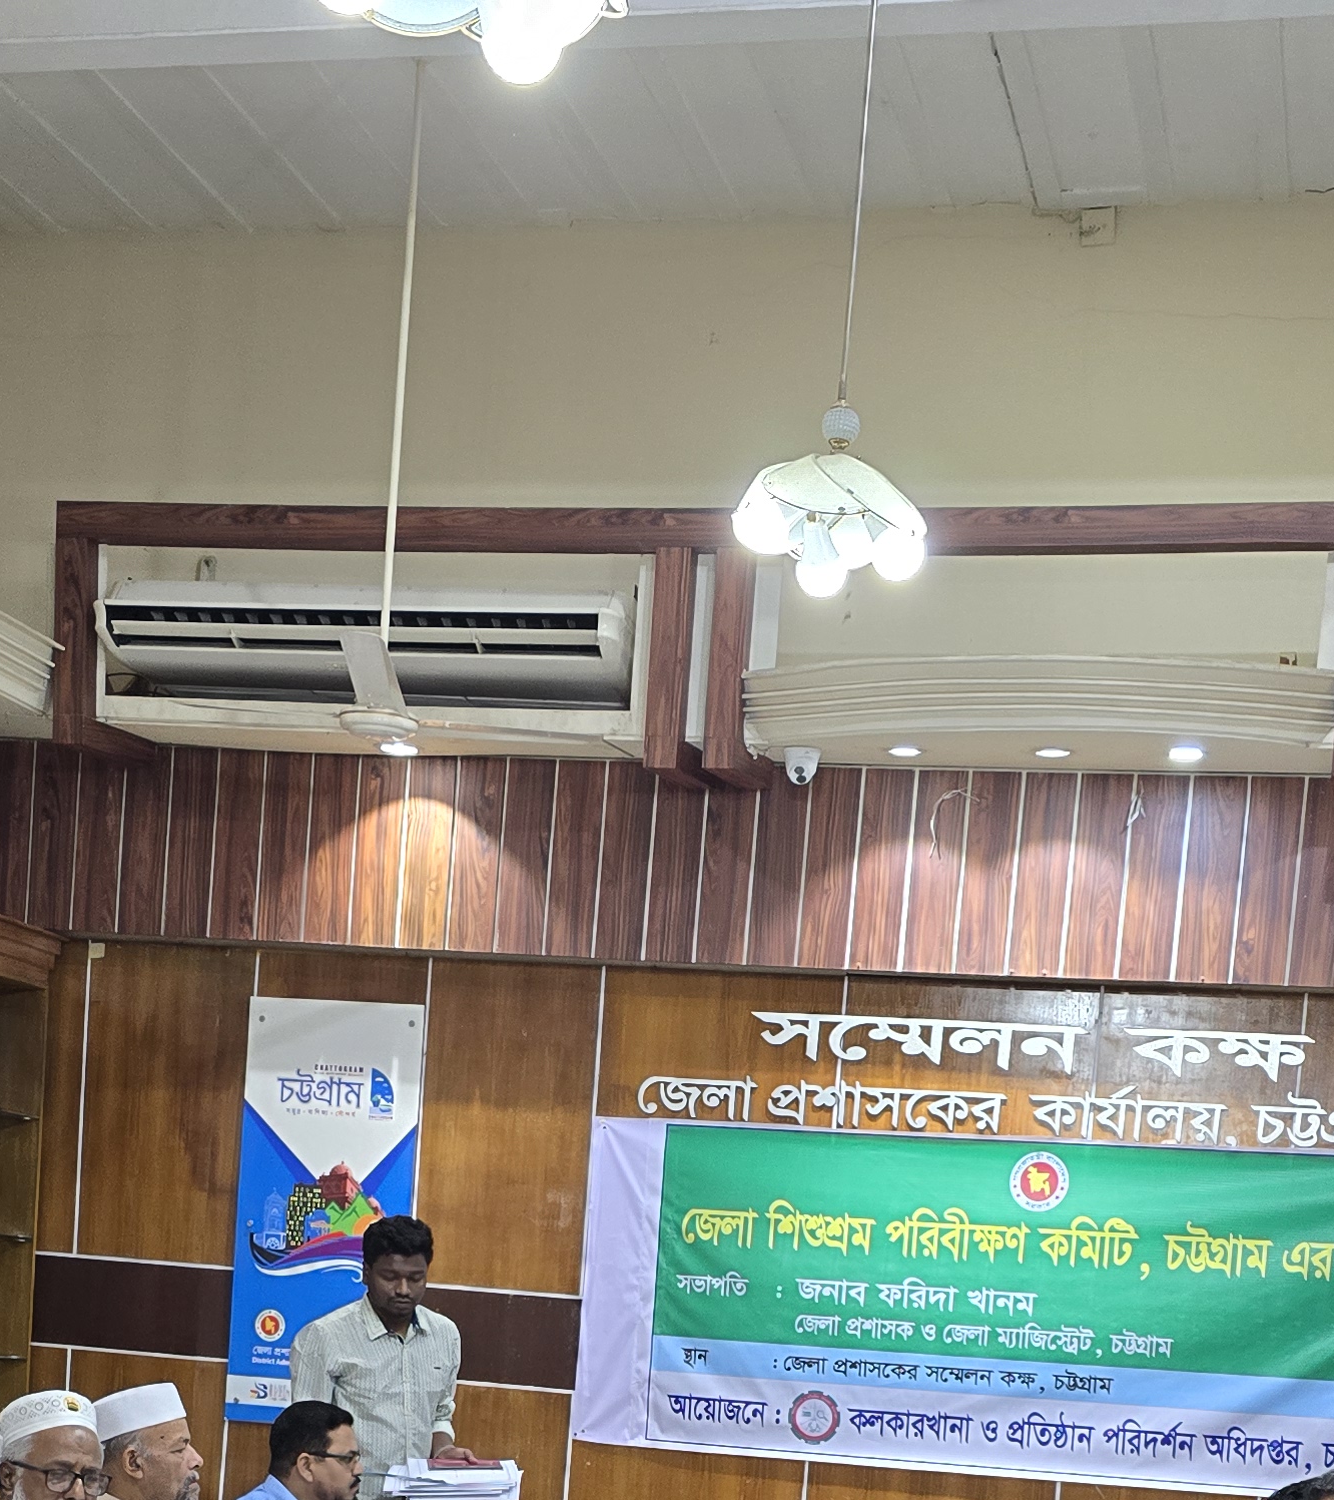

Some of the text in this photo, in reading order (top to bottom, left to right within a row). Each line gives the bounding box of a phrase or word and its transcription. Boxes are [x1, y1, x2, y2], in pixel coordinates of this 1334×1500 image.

[752, 1012, 1315, 1082] সম্মেলন কক্ষ
[277, 1068, 364, 1109] চট্টগ্রাম
[638, 1075, 758, 1122] জেলা
[768, 1079, 1008, 1134] প্রশাসকের
[682, 1208, 758, 1249] জেলা
[766, 1199, 876, 1256] শিশুশ্রম
[885, 1207, 1030, 1264] পরিবীক্ষণ
[1164, 1221, 1273, 1279] চট্টগ্রাম
[676, 1272, 748, 1297] সভাপতি
[795, 1278, 869, 1307] জনাব
[878, 1277, 959, 1312] ফরিদা
[967, 1286, 1038, 1317] খানম
[794, 1314, 841, 1336] জেলা
[846, 1317, 915, 1341] প্রশাসক
[921, 1325, 935, 1342] ও
[943, 1324, 991, 1347] জেলা
[1110, 1329, 1174, 1358] চট্টগ্রাম
[682, 1347, 709, 1368] স্থান
[784, 1355, 828, 1376] জেলা
[833, 1358, 920, 1380] প্রশাসকের
[925, 1364, 995, 1387] সম্মেলন
[1053, 1369, 1114, 1395] চট্টগ্রাম
[668, 1393, 768, 1427] আয়োজনে
[848, 1407, 974, 1444] কলকারখানা
[981, 1420, 997, 1443] ও
[1006, 1411, 1096, 1454] প্রতিষ্ঠান
[1103, 1418, 1197, 1461] পরিদর্শন
